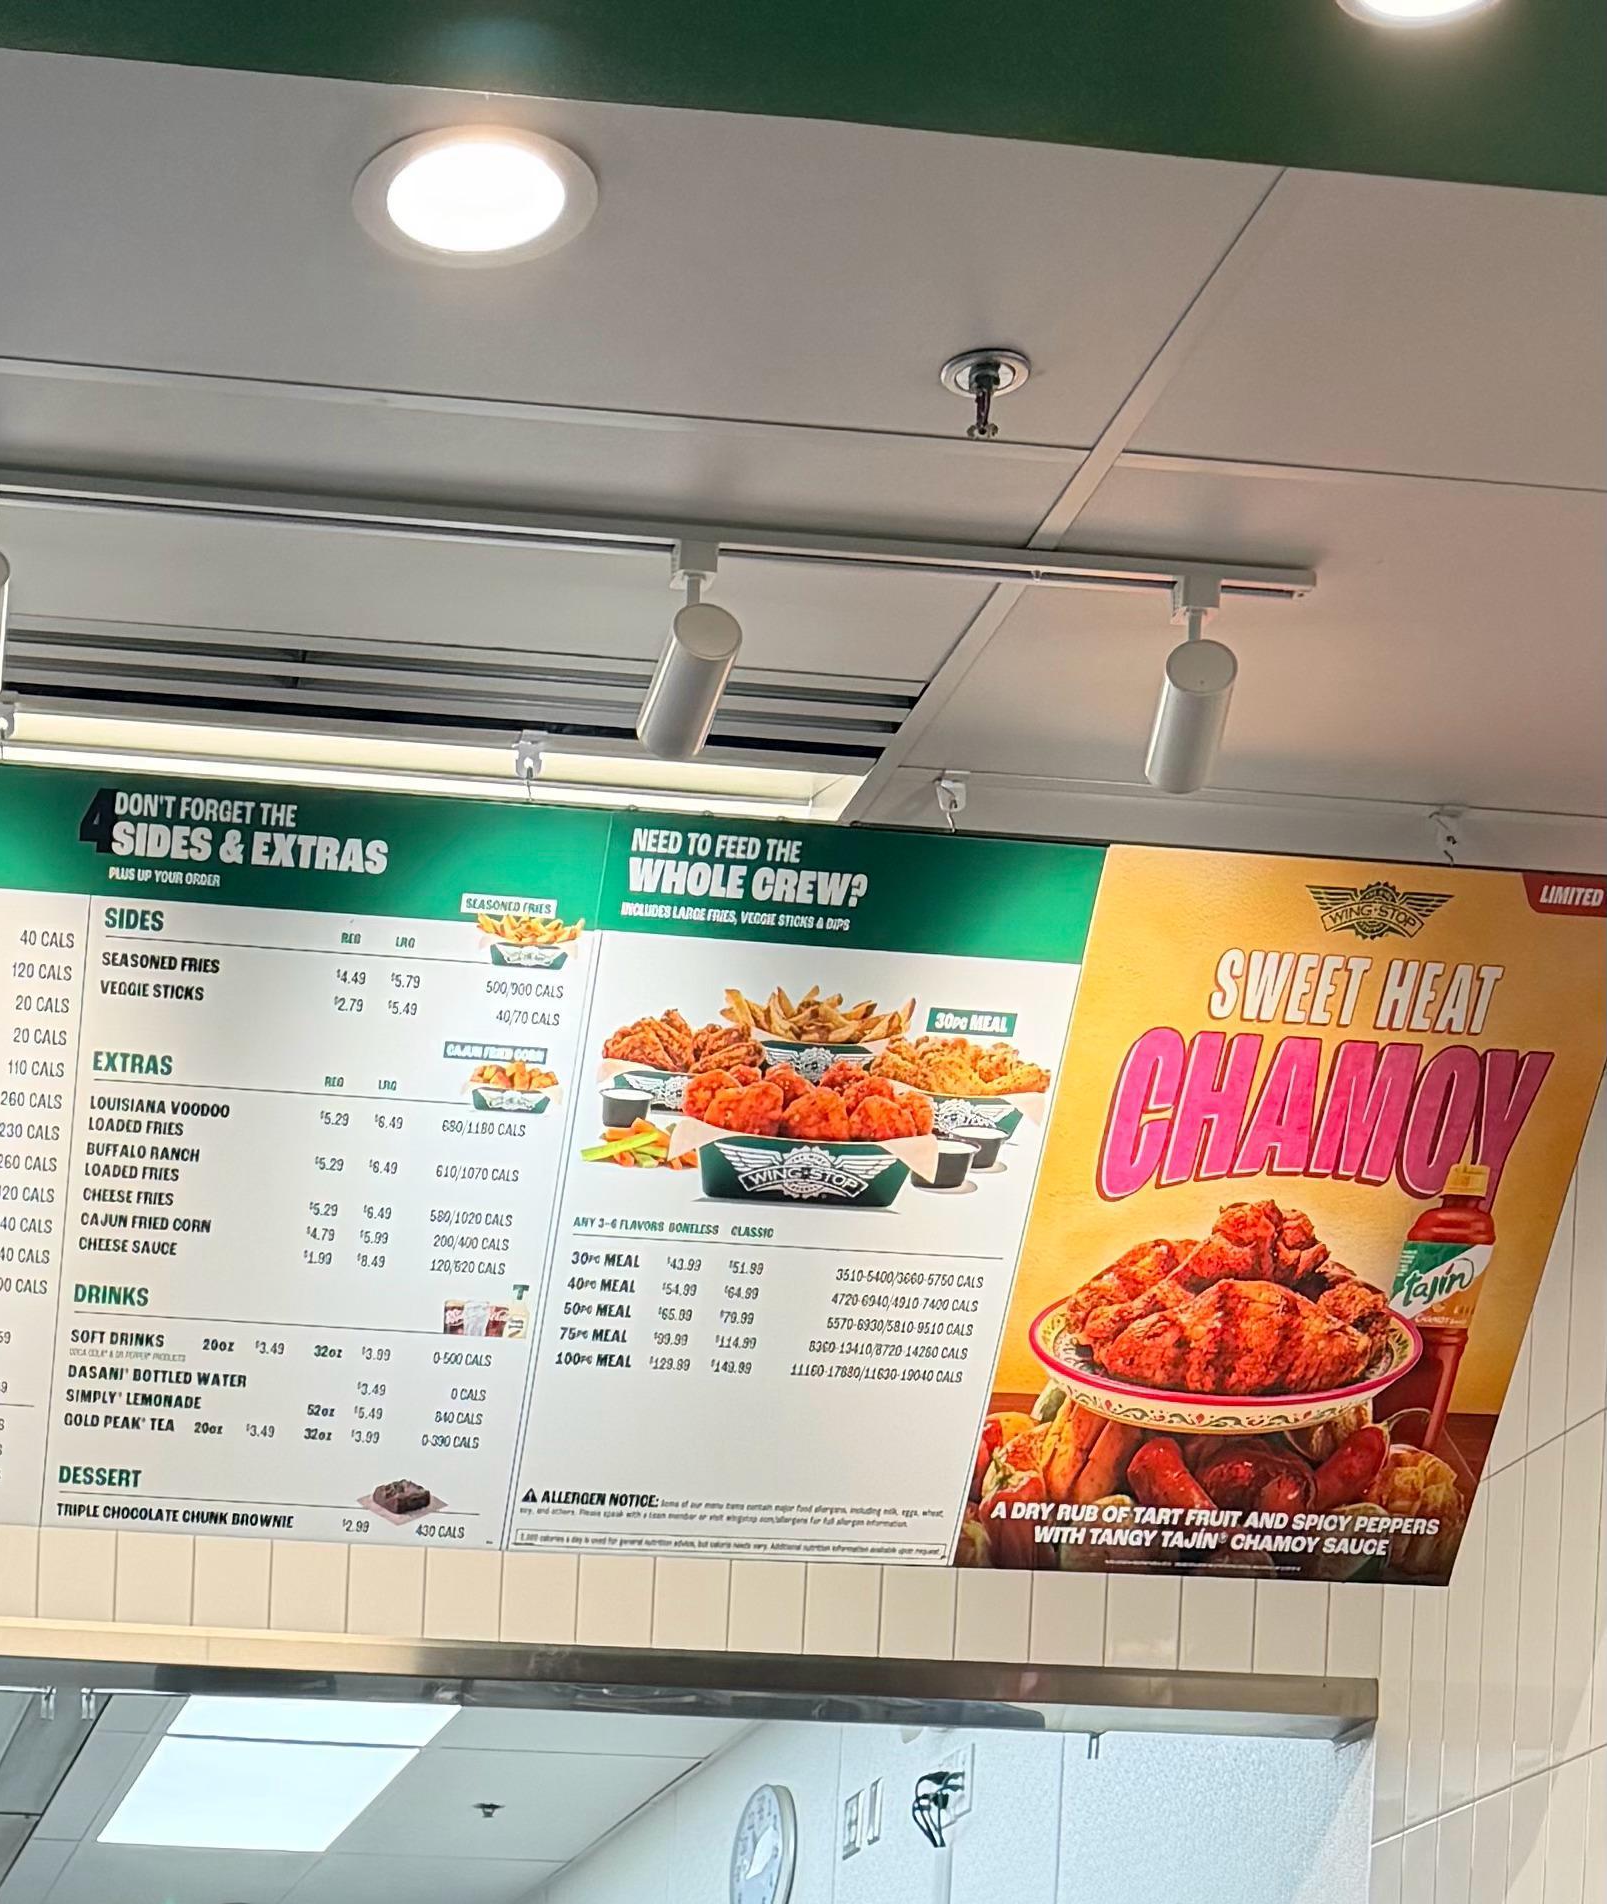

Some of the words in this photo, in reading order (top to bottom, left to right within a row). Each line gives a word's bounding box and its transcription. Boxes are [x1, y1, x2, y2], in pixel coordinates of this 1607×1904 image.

[114, 790, 176, 819] DON'T
[180, 795, 256, 825] FORGET
[260, 802, 298, 828] THE
[111, 820, 214, 860] SIDES
[219, 830, 245, 865] &
[250, 832, 389, 876] EXTRAS
[631, 828, 682, 855] NEED
[687, 832, 712, 857] TO
[714, 835, 761, 861] FEED
[765, 839, 803, 864] THE
[628, 857, 745, 899] WHOLE
[750, 867, 869, 908] CREW?
[1539, 884, 1604, 908] LIMITED
[105, 907, 164, 932] SIDES
[20, 930, 36, 946] 40
[41, 932, 75, 949] CALS
[102, 952, 178, 972] SEASONED
[180, 957, 221, 975] FRIES
[1209, 948, 1375, 1027] SWEET
[1375, 958, 1505, 1036] HEAT
[1095, 1027, 1555, 1202] CHAMOY
[73, 1284, 149, 1307] DRINKS
[58, 1465, 142, 1488] DESSERT
[541, 1490, 607, 1506] ALLERGEN
[609, 1493, 660, 1509] NOTICE:
[990, 1501, 1007, 1520] A
[1010, 1502, 1055, 1521] DRY
[1057, 1505, 1099, 1524] RUB
[1101, 1507, 1130, 1524] OF
[1132, 1508, 1183, 1527] TART
[1187, 1509, 1244, 1529] FRUIT
[1246, 1511, 1288, 1531] AND
[1292, 1513, 1350, 1534] SPICY
[1354, 1515, 1440, 1536] PEPPERS
[1033, 1525, 1085, 1545] WITH
[1089, 1528, 1157, 1549] TANGY
[1231, 1532, 1320, 1555] CHAMOY
[1323, 1535, 1388, 1557] SAUCE
